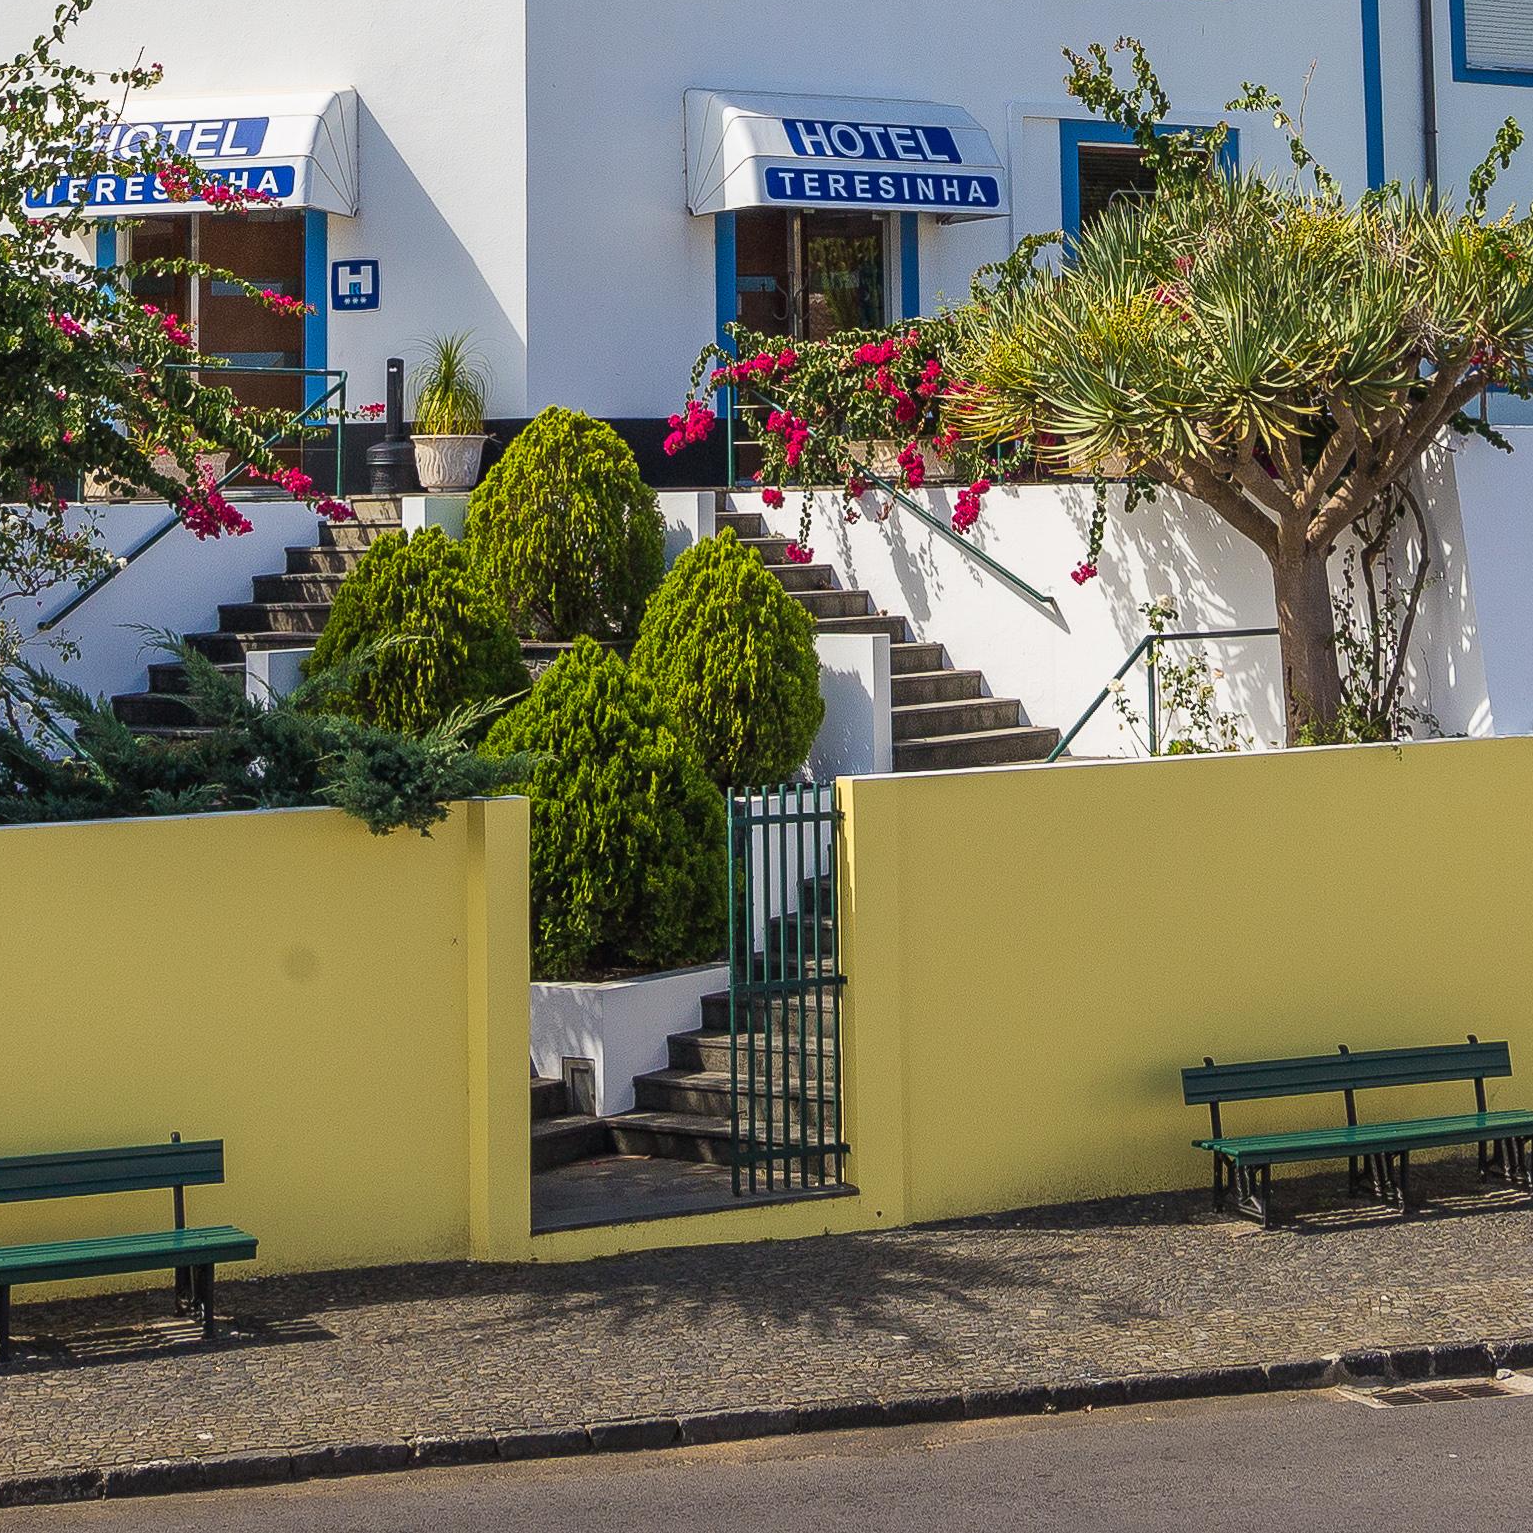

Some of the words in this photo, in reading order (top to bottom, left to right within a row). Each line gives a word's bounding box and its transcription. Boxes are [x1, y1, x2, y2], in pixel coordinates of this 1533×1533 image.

[794, 121, 951, 163] HOTEL
[777, 171, 988, 204] TERESINHA
[338, 265, 373, 296] H
